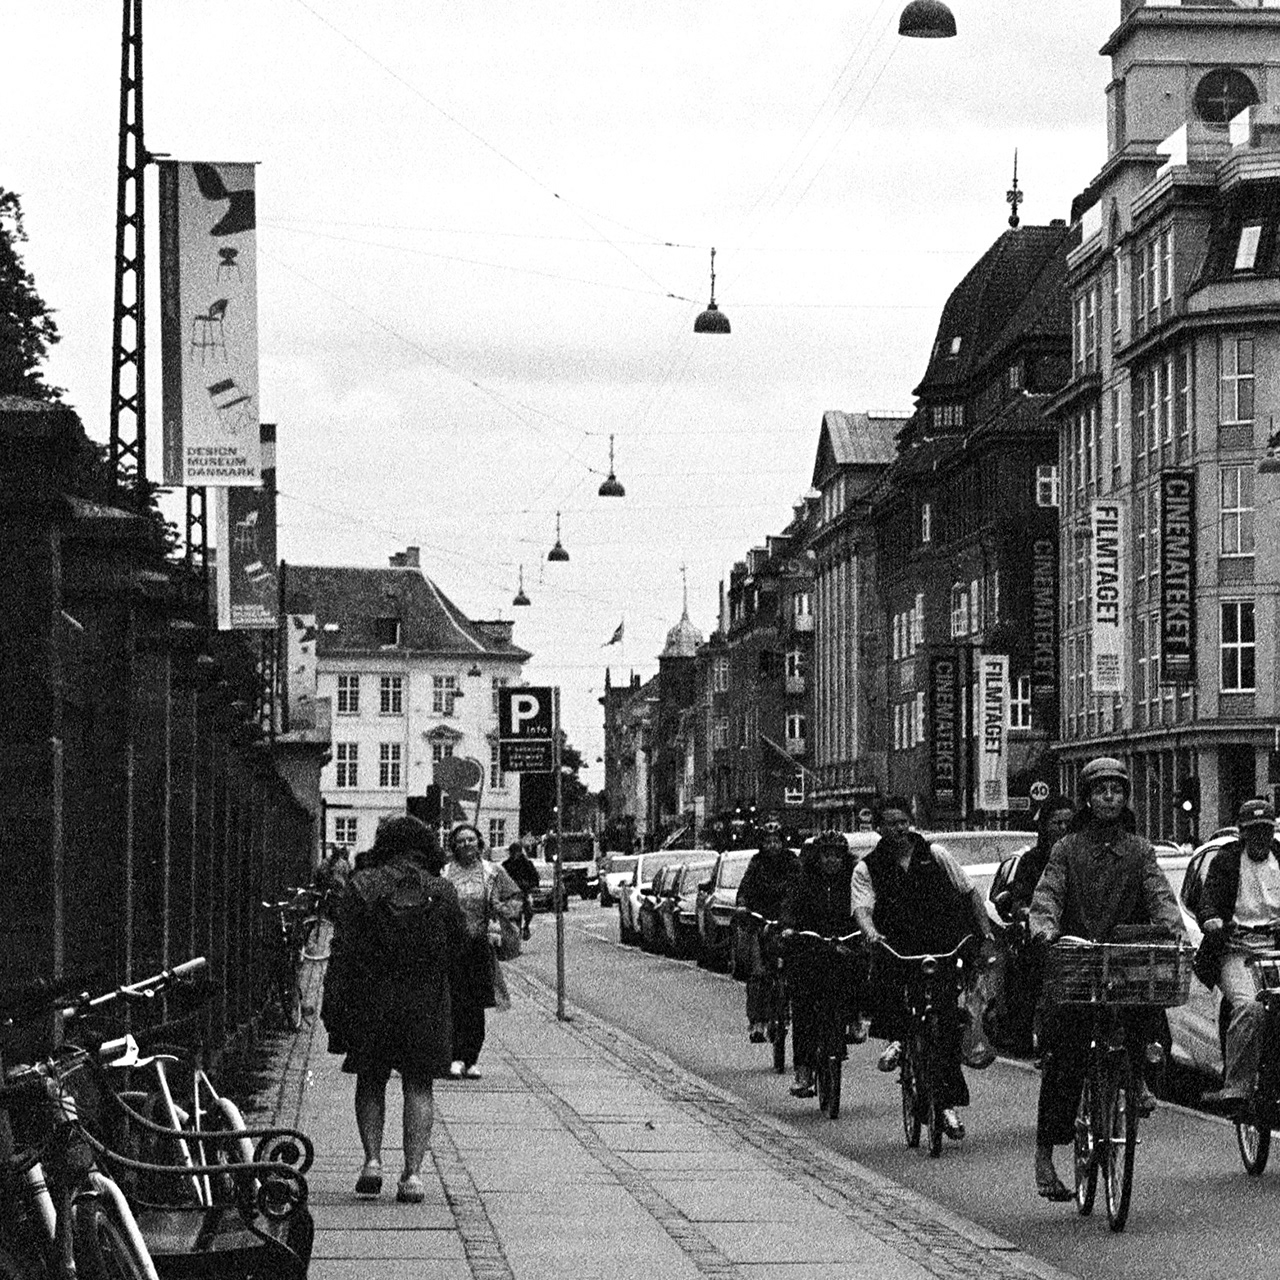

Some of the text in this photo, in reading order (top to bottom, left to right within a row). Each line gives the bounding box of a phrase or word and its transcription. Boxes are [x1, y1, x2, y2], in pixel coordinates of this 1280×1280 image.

[186, 447, 238, 456] DESIGN
[186, 458, 247, 467] MUSEUM
[186, 468, 255, 477] DANMARK
[1096, 506, 1119, 628] FILMTAGET
[1165, 479, 1190, 647] CINEMATEKET
[1033, 540, 1053, 680] CINEMATEKET
[511, 694, 540, 734] P
[935, 661, 954, 784] CINEMATEKET
[985, 661, 1003, 757] FILMTAGET
[1031, 785, 1048, 797] 40
